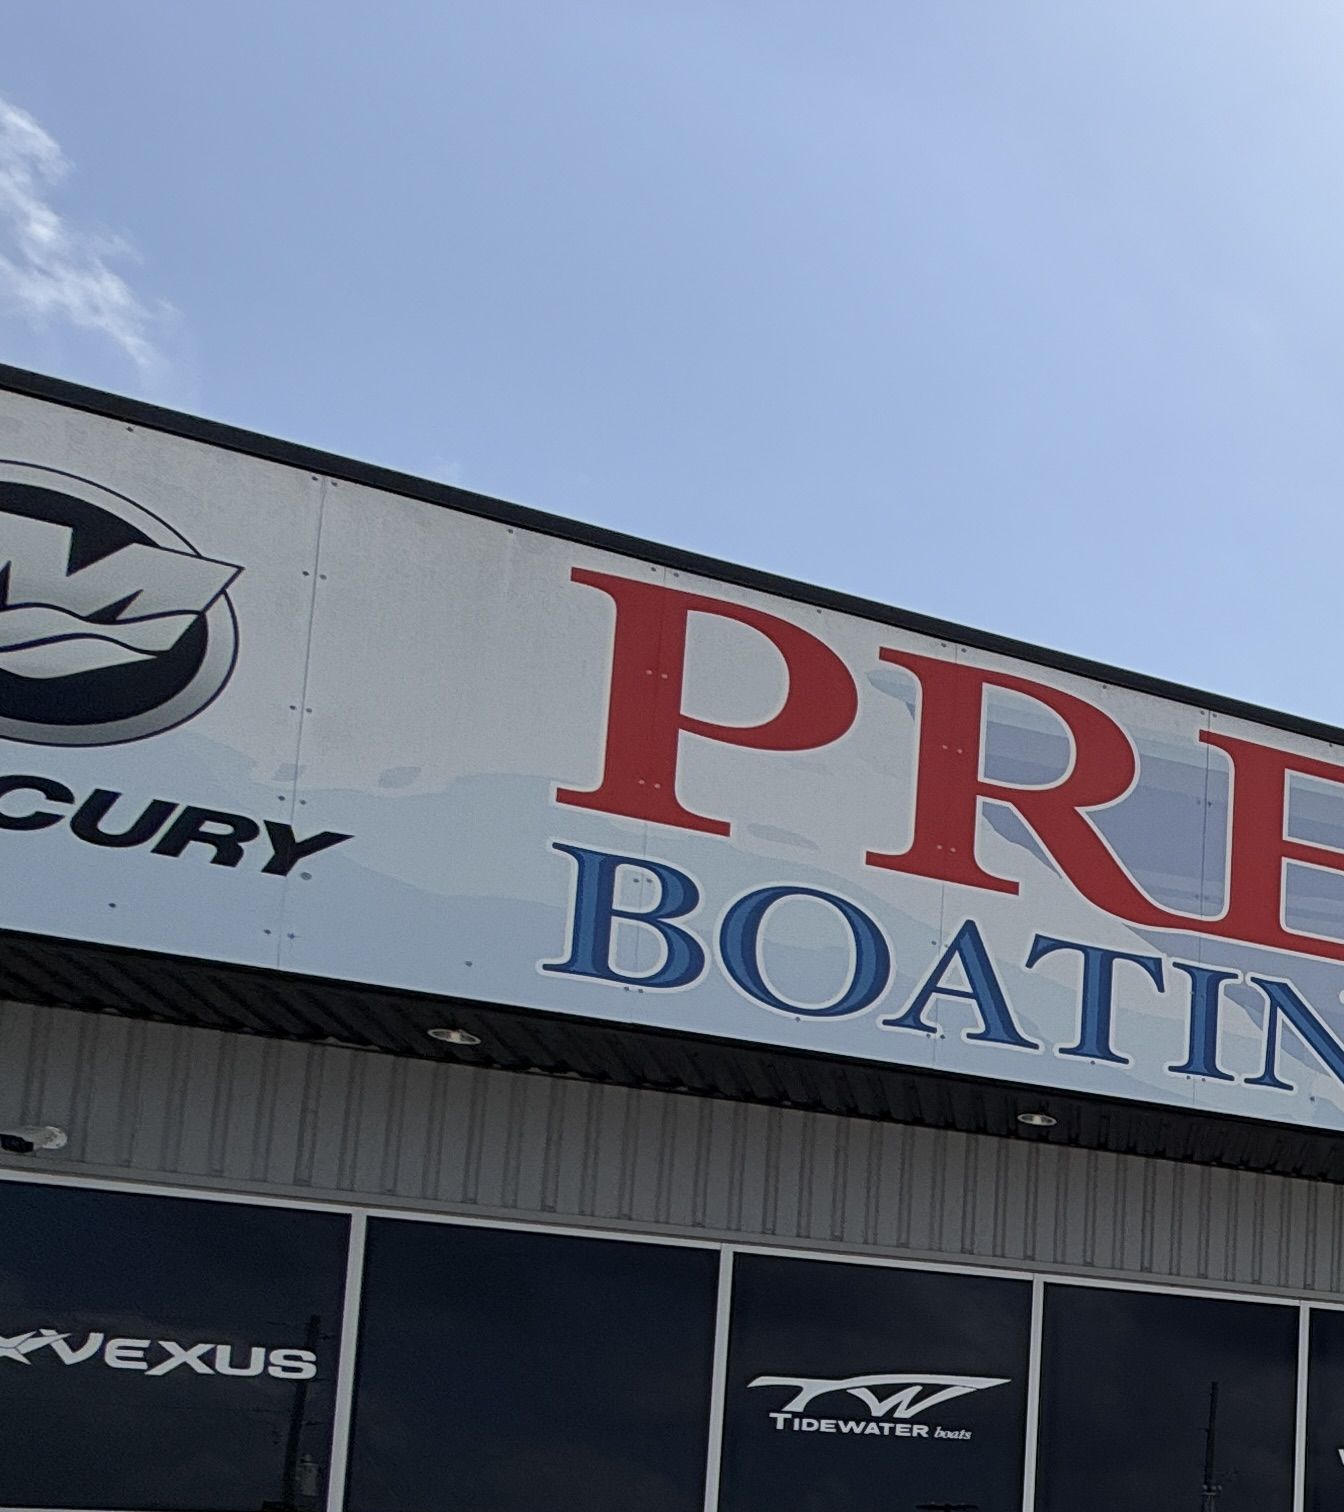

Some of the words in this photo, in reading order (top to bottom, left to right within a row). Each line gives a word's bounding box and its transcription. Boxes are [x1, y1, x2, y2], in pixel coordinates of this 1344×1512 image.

[0, 775, 355, 876] CURY
[39, 1328, 317, 1379] VEXUS
[769, 1413, 929, 1437] TIDEWATER
[934, 1426, 972, 1440] boats
